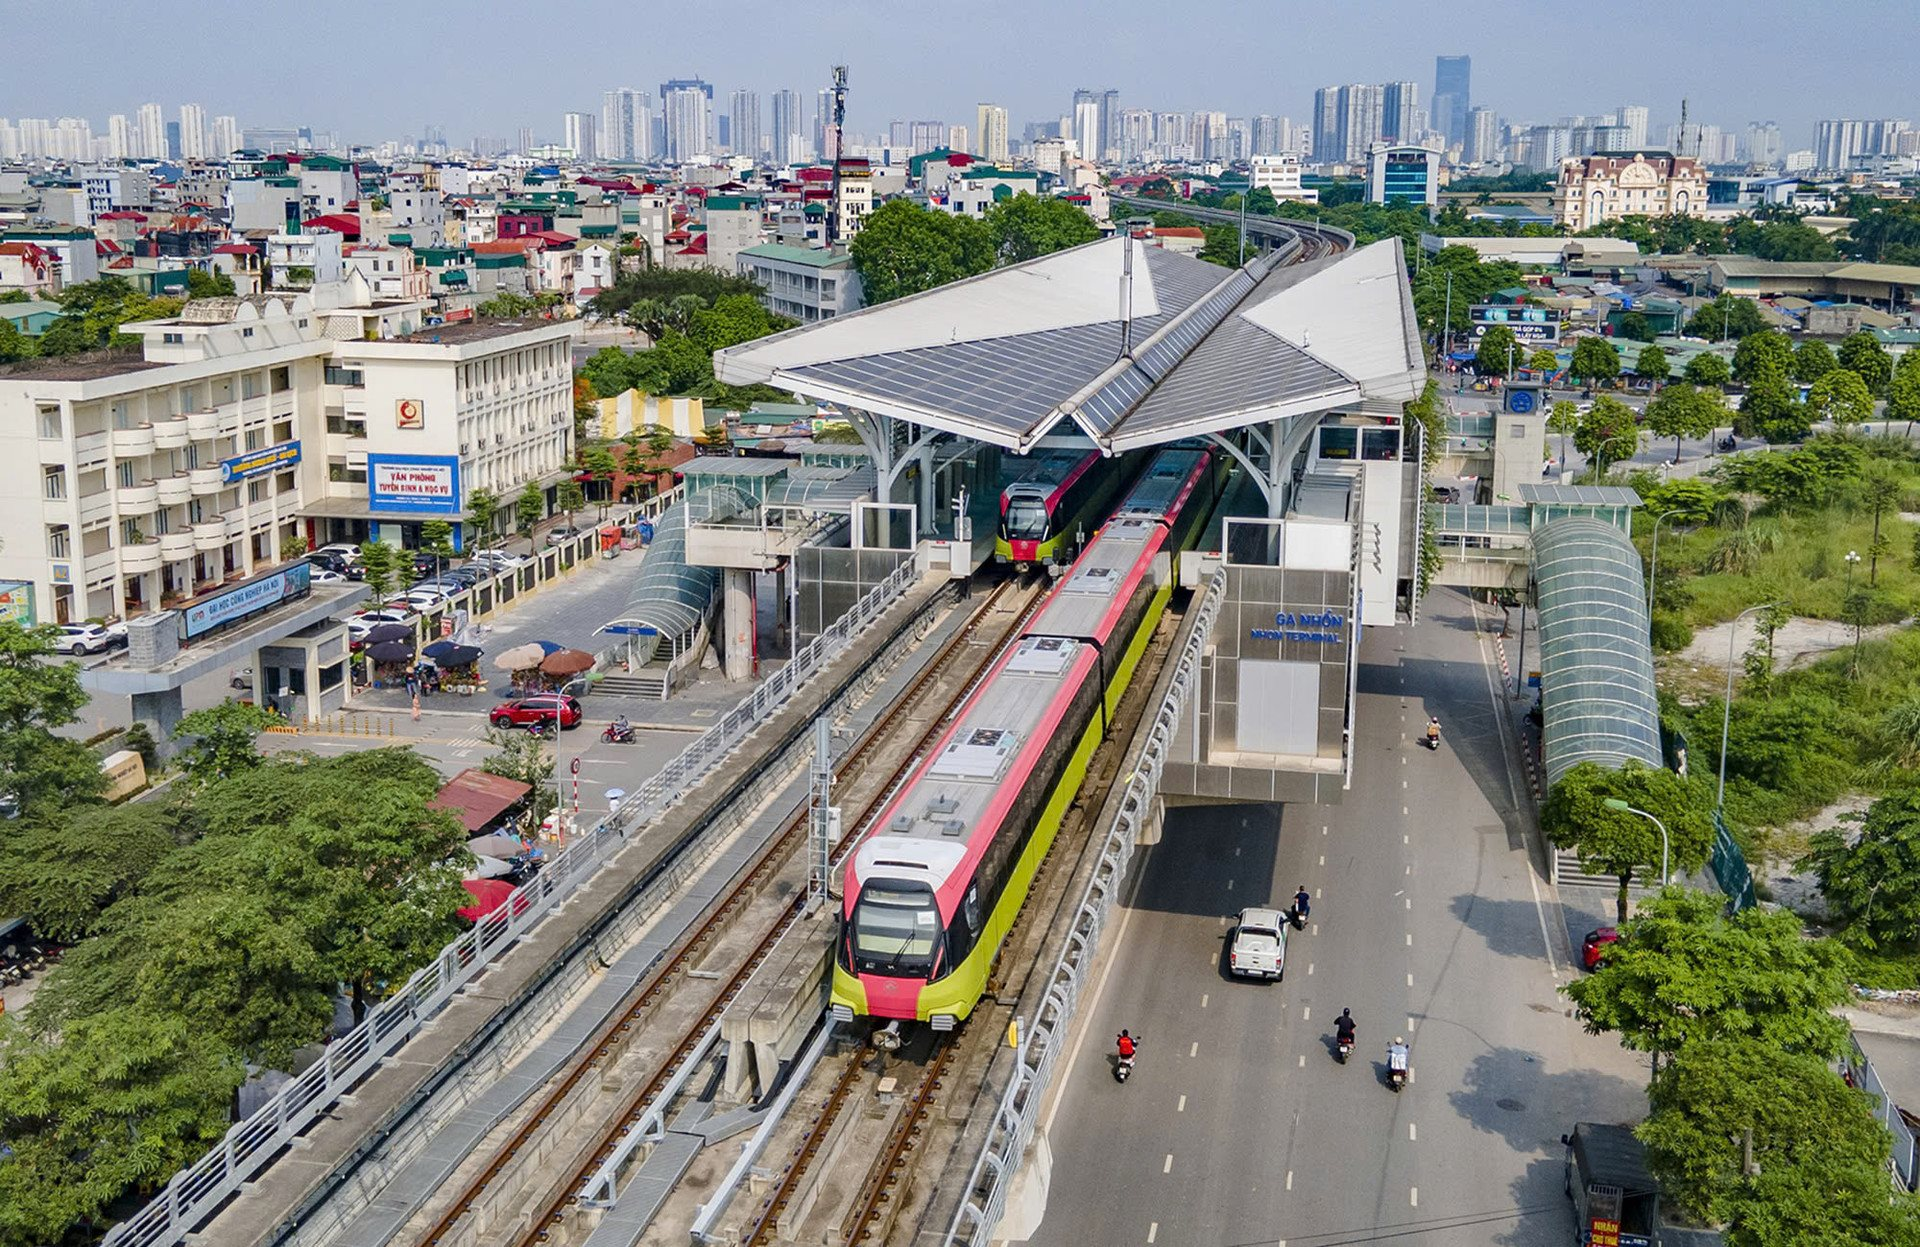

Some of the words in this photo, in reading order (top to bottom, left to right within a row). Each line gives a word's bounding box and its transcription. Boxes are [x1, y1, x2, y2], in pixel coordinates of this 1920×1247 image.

[391, 472, 406, 481] VĂN
[410, 473, 436, 482] PHÒNG
[379, 481, 399, 492] TUYỂN
[401, 484, 417, 492] SINH
[425, 485, 438, 494] HỌC
[1275, 612, 1296, 627] GA
[1285, 630, 1343, 644] TERMINAL
